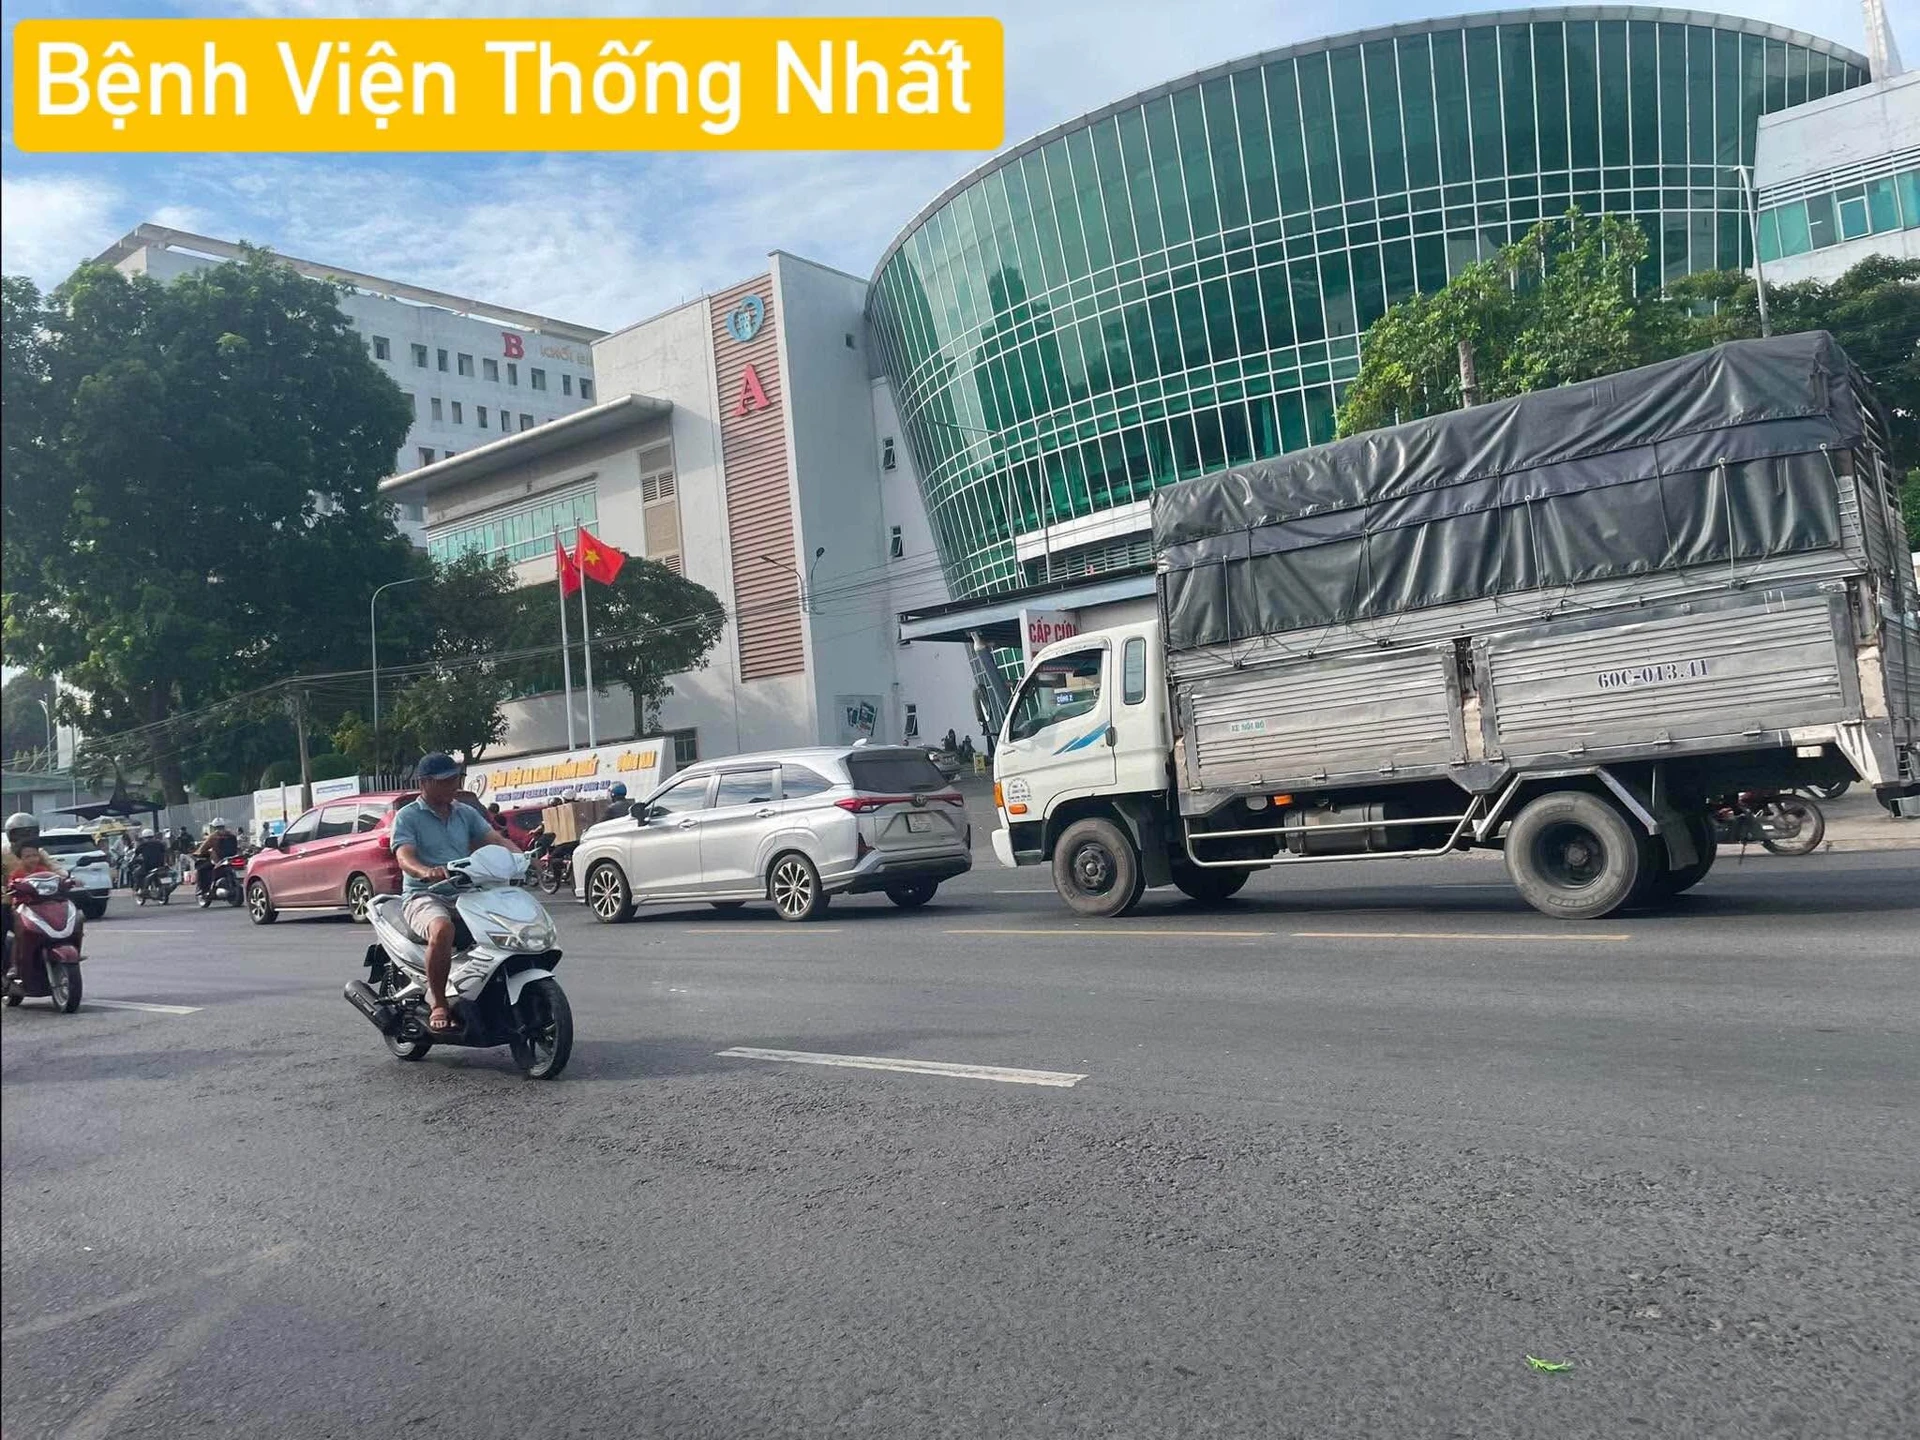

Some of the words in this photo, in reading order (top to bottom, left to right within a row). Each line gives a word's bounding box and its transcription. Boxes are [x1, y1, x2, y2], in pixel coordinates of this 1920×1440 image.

[501, 331, 525, 359] B
[732, 363, 771, 416] A
[1029, 615, 1051, 643] CẤP
